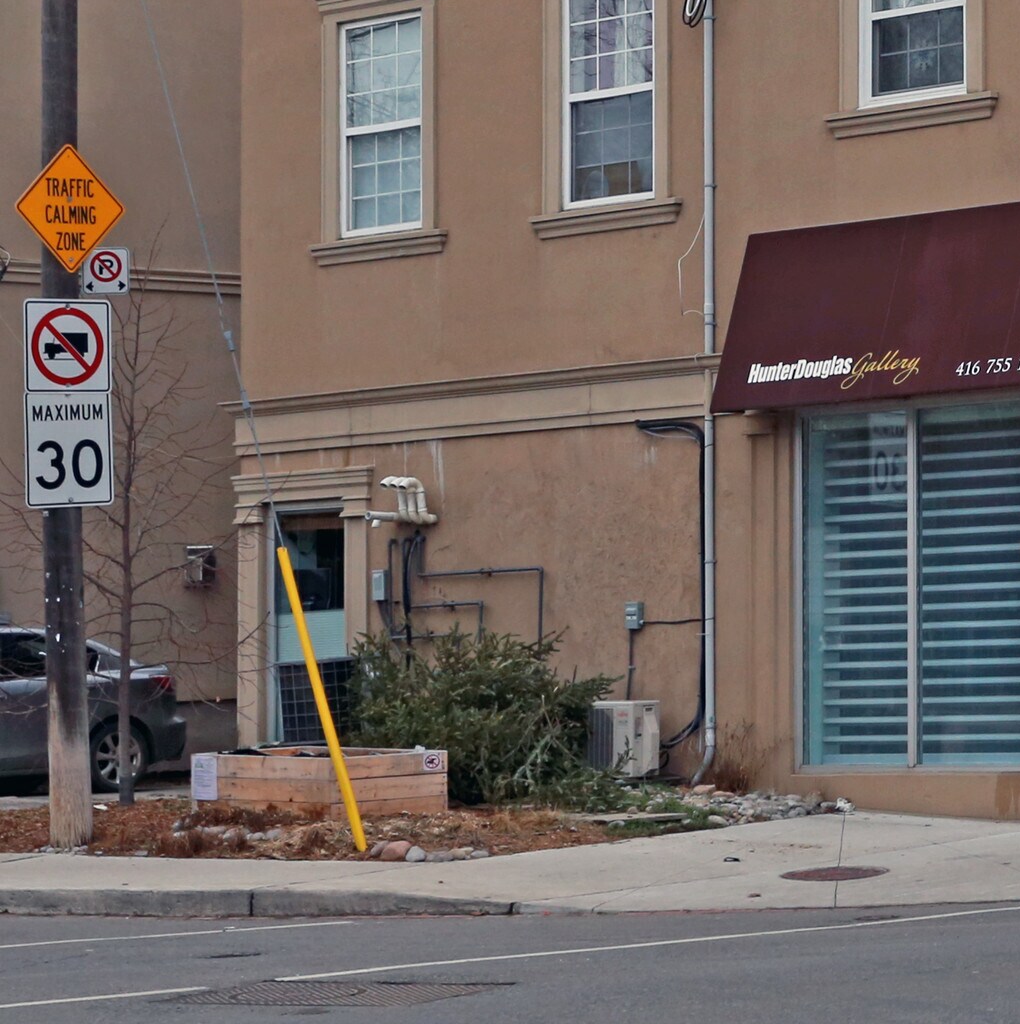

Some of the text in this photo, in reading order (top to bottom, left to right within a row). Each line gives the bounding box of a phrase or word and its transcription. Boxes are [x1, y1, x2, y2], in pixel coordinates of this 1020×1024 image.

[45, 177, 95, 199] TRAFFIC
[45, 206, 96, 225] CALMING
[56, 232, 86, 251] ZONE
[840, 349, 921, 389] Gallery
[955, 360, 980, 377] 416
[986, 357, 1012, 374] 755
[32, 404, 104, 422] MAXIMUM
[35, 439, 104, 490] 30
